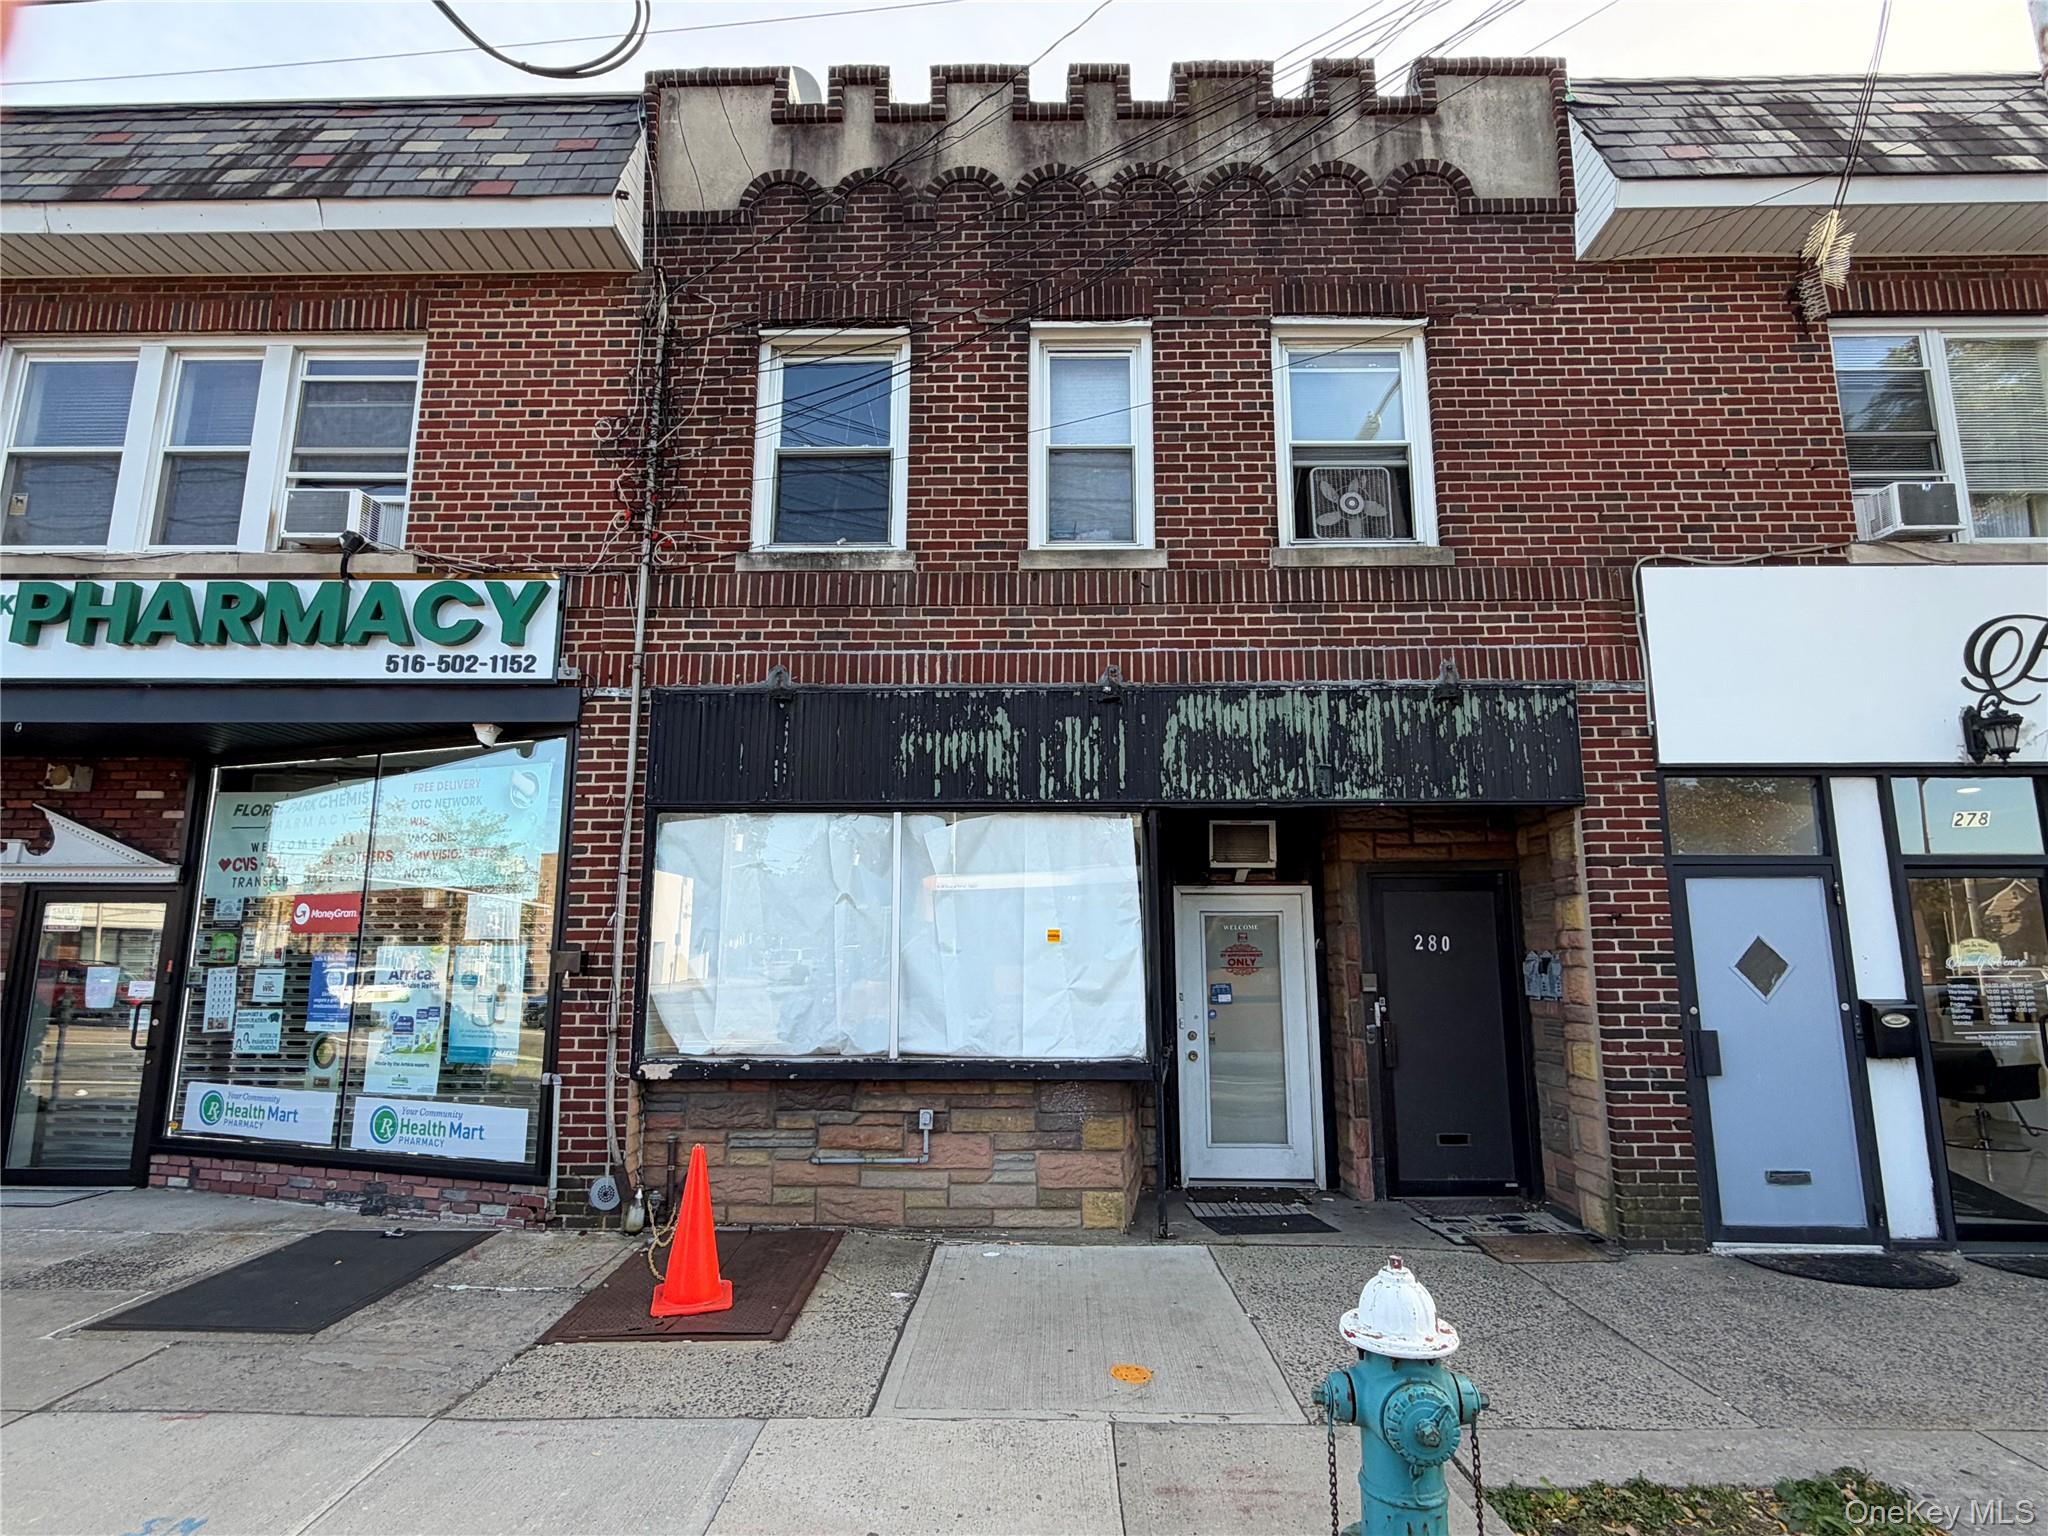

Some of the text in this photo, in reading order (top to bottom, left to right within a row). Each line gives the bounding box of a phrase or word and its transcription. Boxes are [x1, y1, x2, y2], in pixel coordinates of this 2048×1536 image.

[8, 581, 552, 647] PHARMACY
[385, 654, 537, 674] 516-502-1152
[413, 778, 481, 793] FREE DELIVERY
[233, 803, 284, 817] FLORL
[319, 789, 384, 809] CHEMISS
[411, 795, 482, 810] OTC NETWORK
[265, 813, 348, 833] HARMACY
[1954, 812, 1989, 827] 278
[232, 856, 258, 872] CVS
[311, 908, 357, 920] MoneyGram
[1414, 934, 1450, 952] 280
[1227, 958, 1257, 967] ONLY
[262, 985, 275, 993] WIC
[227, 1091, 281, 1104] Your Community
[225, 1102, 298, 1123] Health Mart
[401, 1106, 464, 1120] Your Community
[223, 1118, 264, 1130] PHARMACY
[399, 1117, 485, 1141] Health Mart
[398, 1136, 445, 1148] PHARMACY
